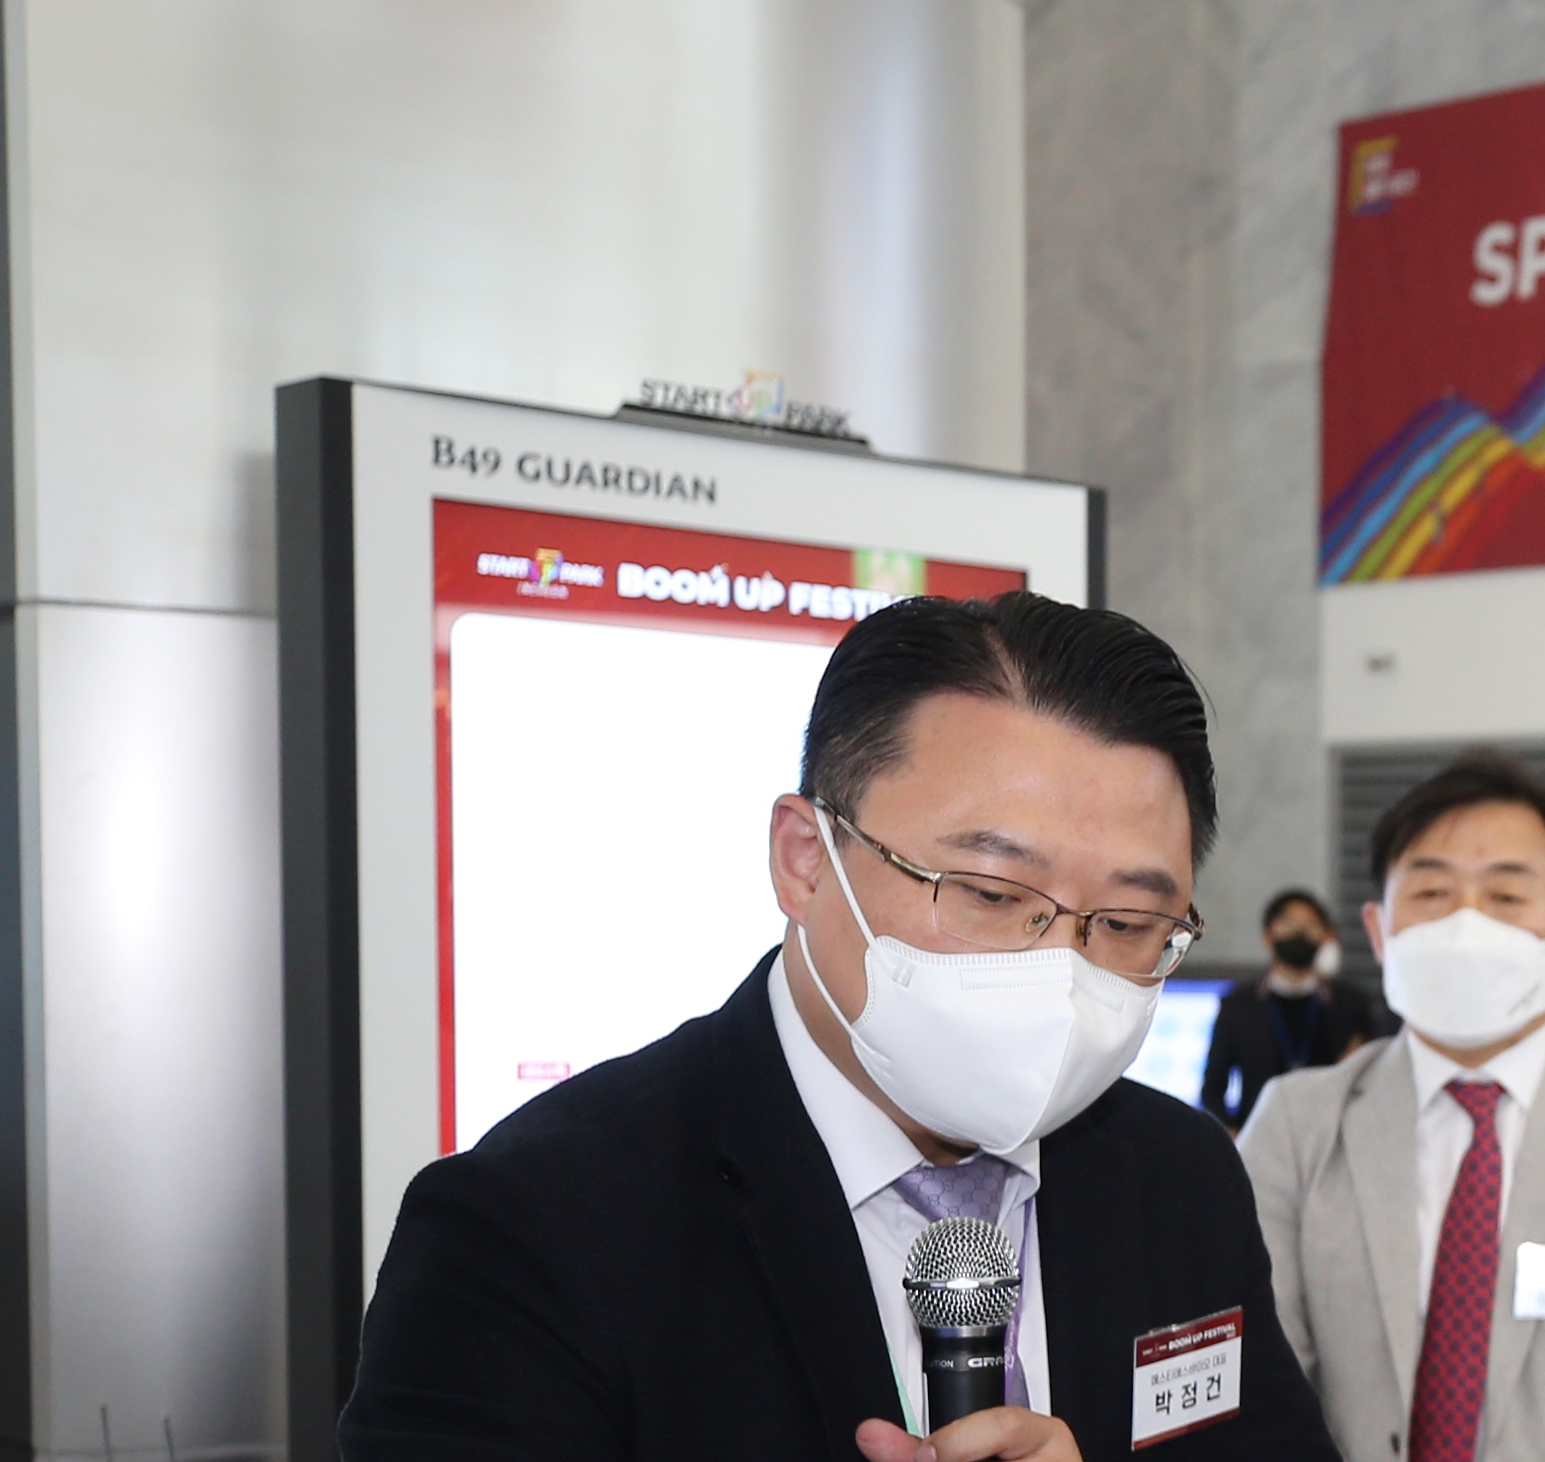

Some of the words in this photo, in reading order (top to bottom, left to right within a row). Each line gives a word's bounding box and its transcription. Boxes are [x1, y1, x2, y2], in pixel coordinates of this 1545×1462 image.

[431, 434, 501, 477] B49
[517, 452, 719, 504] GUARDIAN
[617, 561, 731, 608] BOOM
[734, 573, 786, 612] UP
[1168, 1333, 1192, 1351] BOOM
[1192, 1331, 1203, 1343] UP
[1203, 1322, 1236, 1341] FESTIVAL
